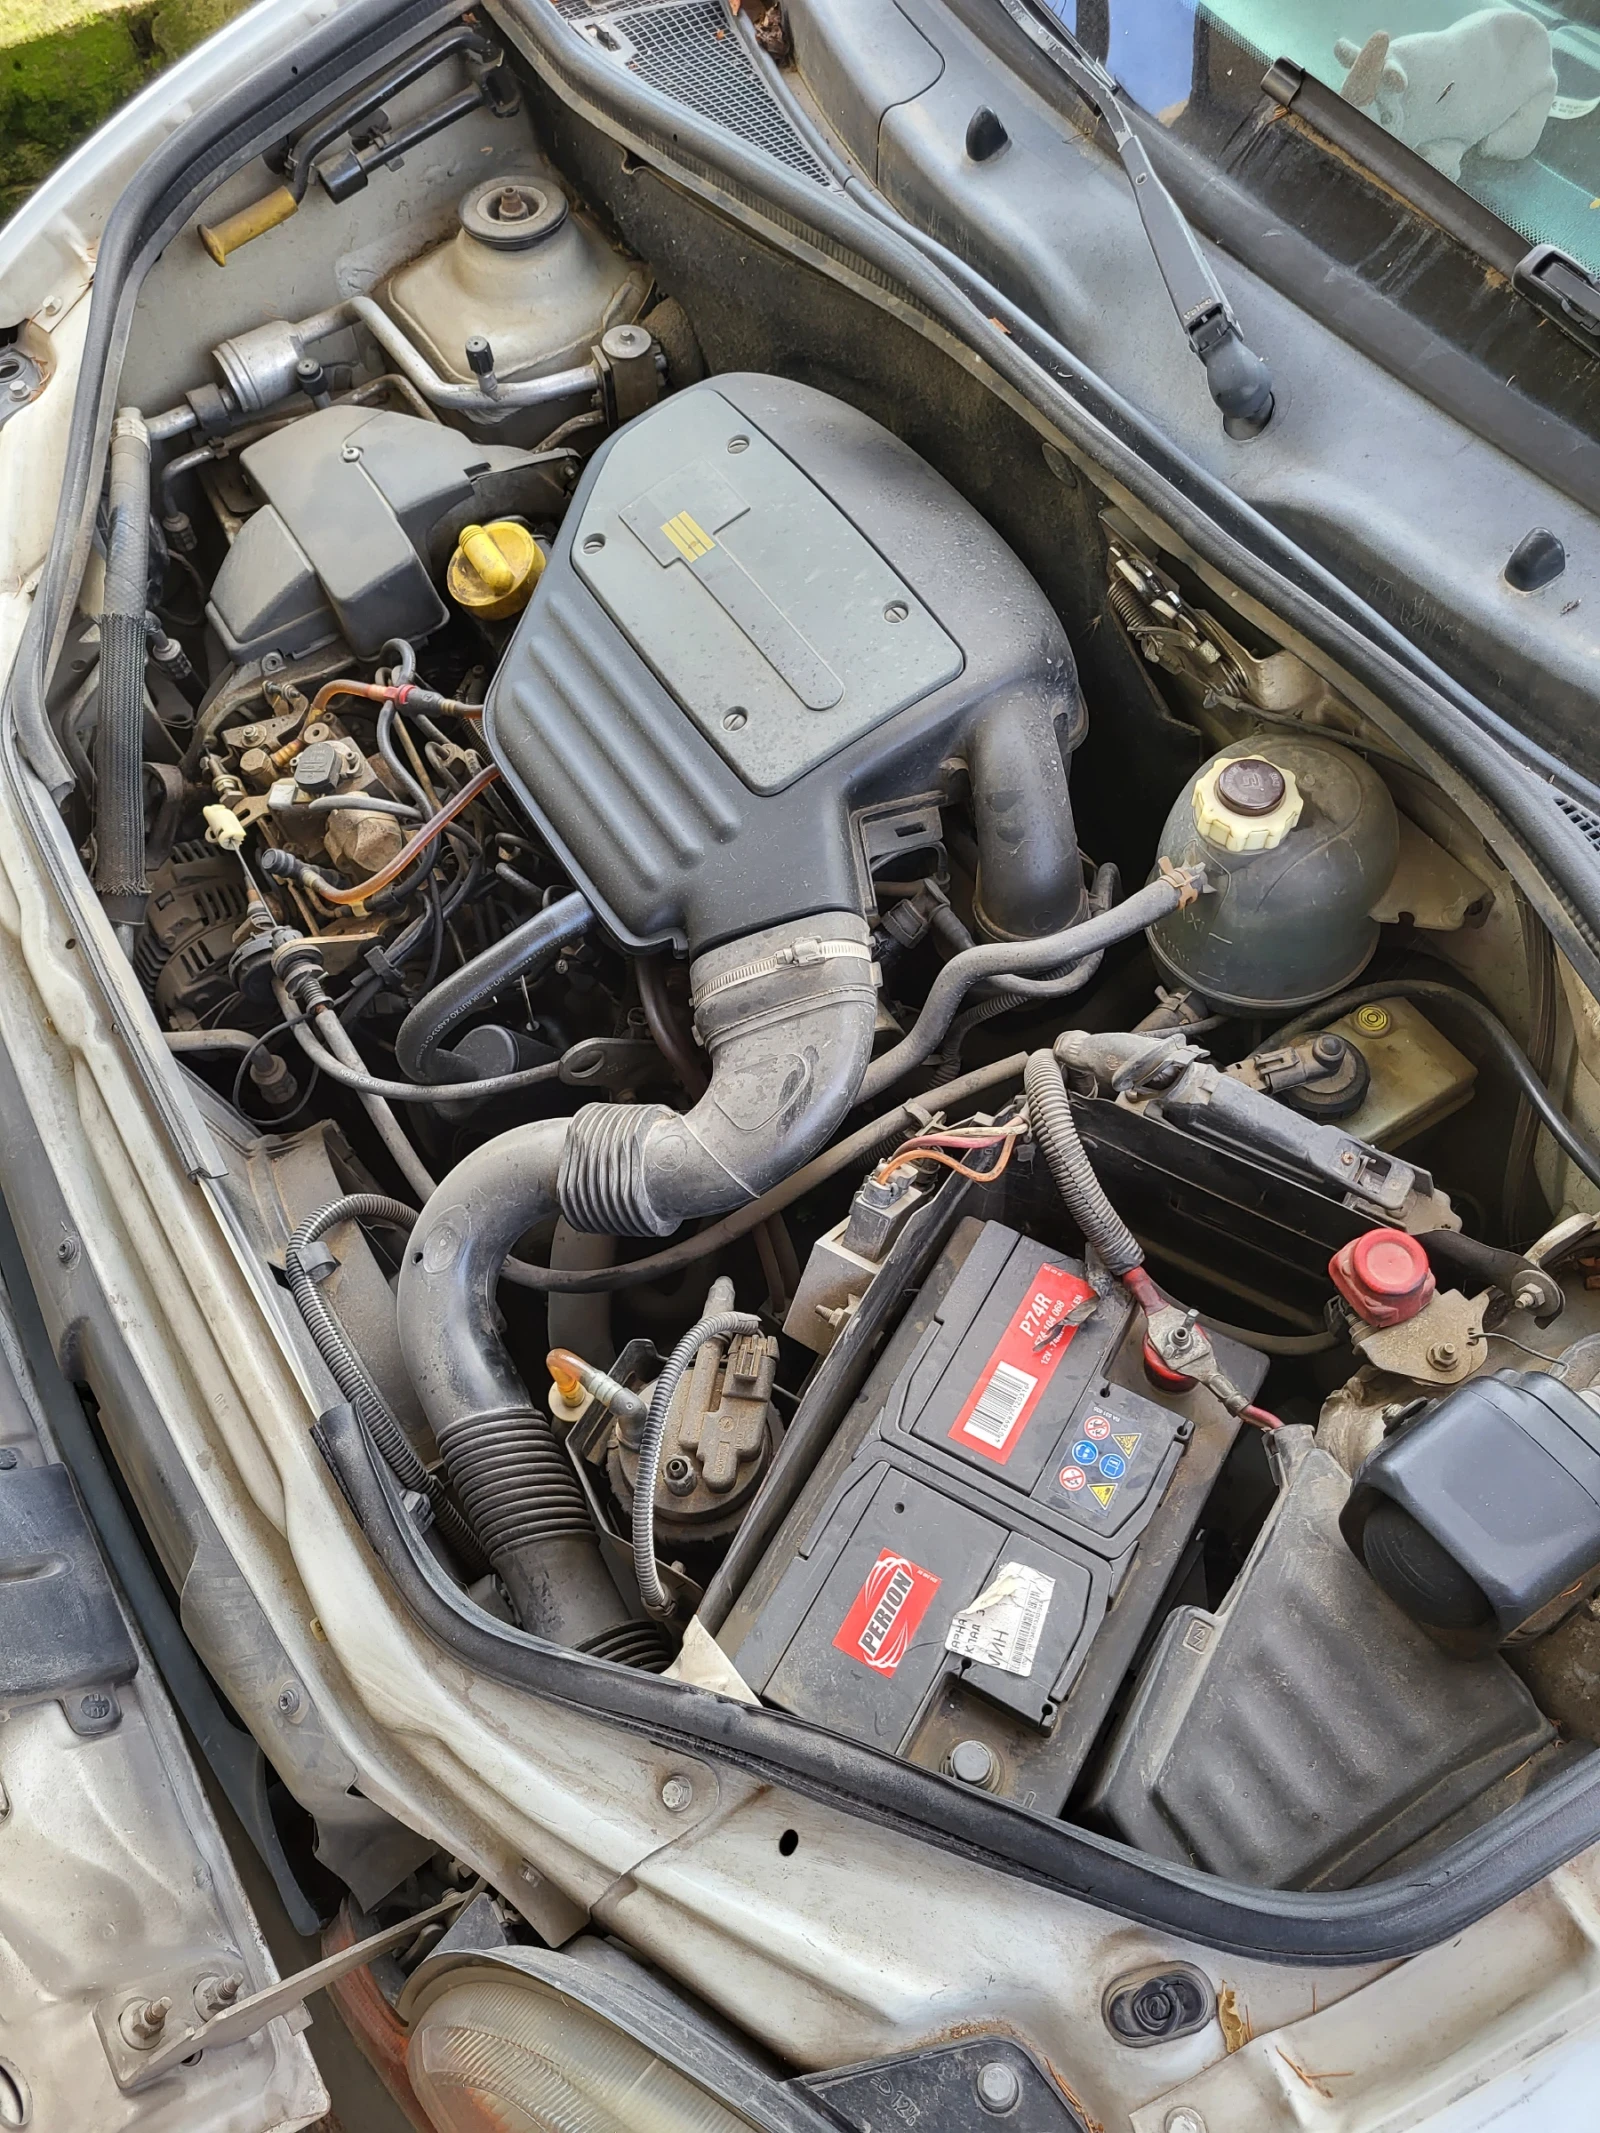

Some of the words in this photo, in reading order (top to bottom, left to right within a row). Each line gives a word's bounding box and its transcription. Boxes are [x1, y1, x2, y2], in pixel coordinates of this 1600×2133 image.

[1019, 1293, 1053, 1338] P74R
[1040, 1350, 1052, 1365] 12V
[1072, 1294, 1083, 1305] EN
[1043, 1315, 1057, 1331] 104
[1051, 1299, 1065, 1317] 068
[860, 1571, 912, 1655] PERION
